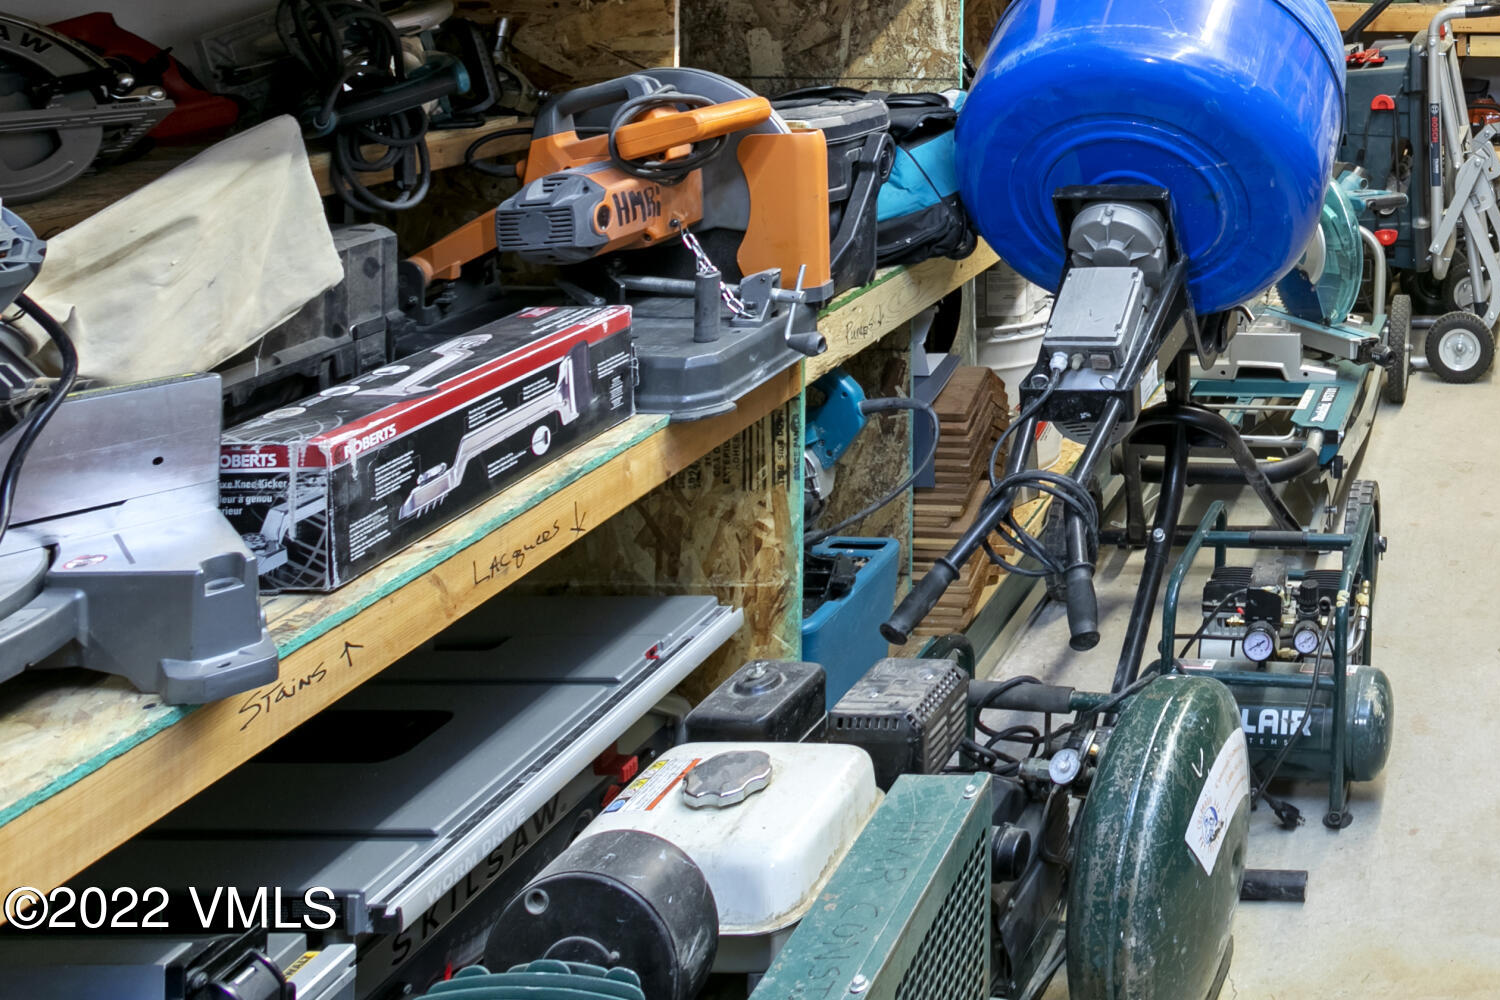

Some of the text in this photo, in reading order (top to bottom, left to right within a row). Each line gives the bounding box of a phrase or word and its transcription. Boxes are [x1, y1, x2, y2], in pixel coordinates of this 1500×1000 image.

[343, 422, 399, 460] ROBERTS
[235, 479, 256, 490] Knee
[258, 479, 288, 490] Kicker
[245, 493, 273, 506] genou
